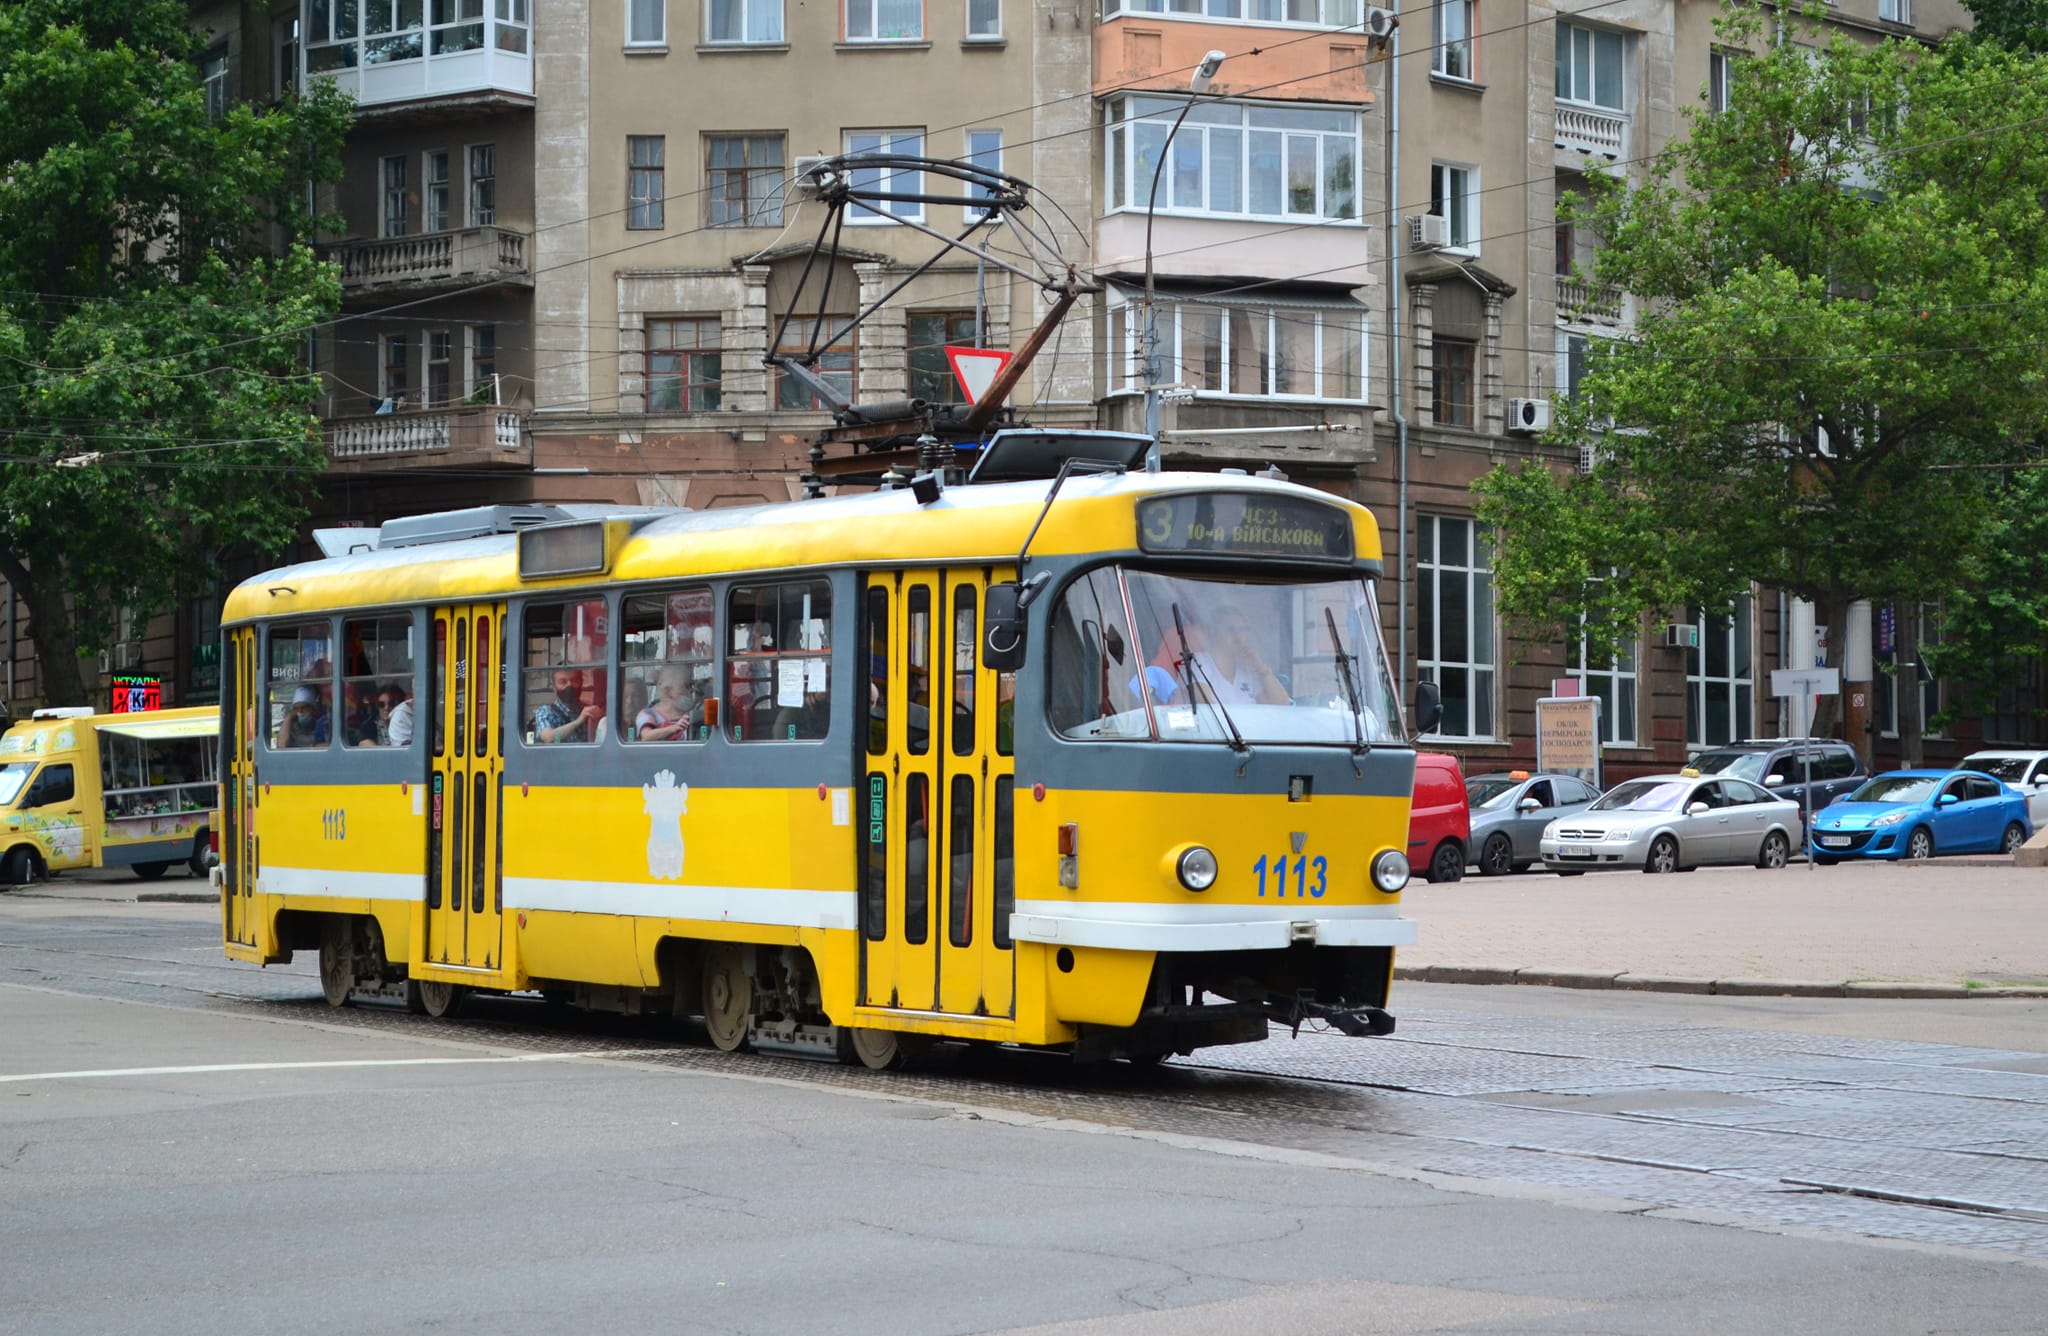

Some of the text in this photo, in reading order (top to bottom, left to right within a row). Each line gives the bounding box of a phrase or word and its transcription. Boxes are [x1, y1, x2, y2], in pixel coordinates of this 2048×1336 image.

[1144, 501, 1173, 542] 3
[322, 808, 346, 841] 1113
[1252, 854, 1328, 898] 1113
